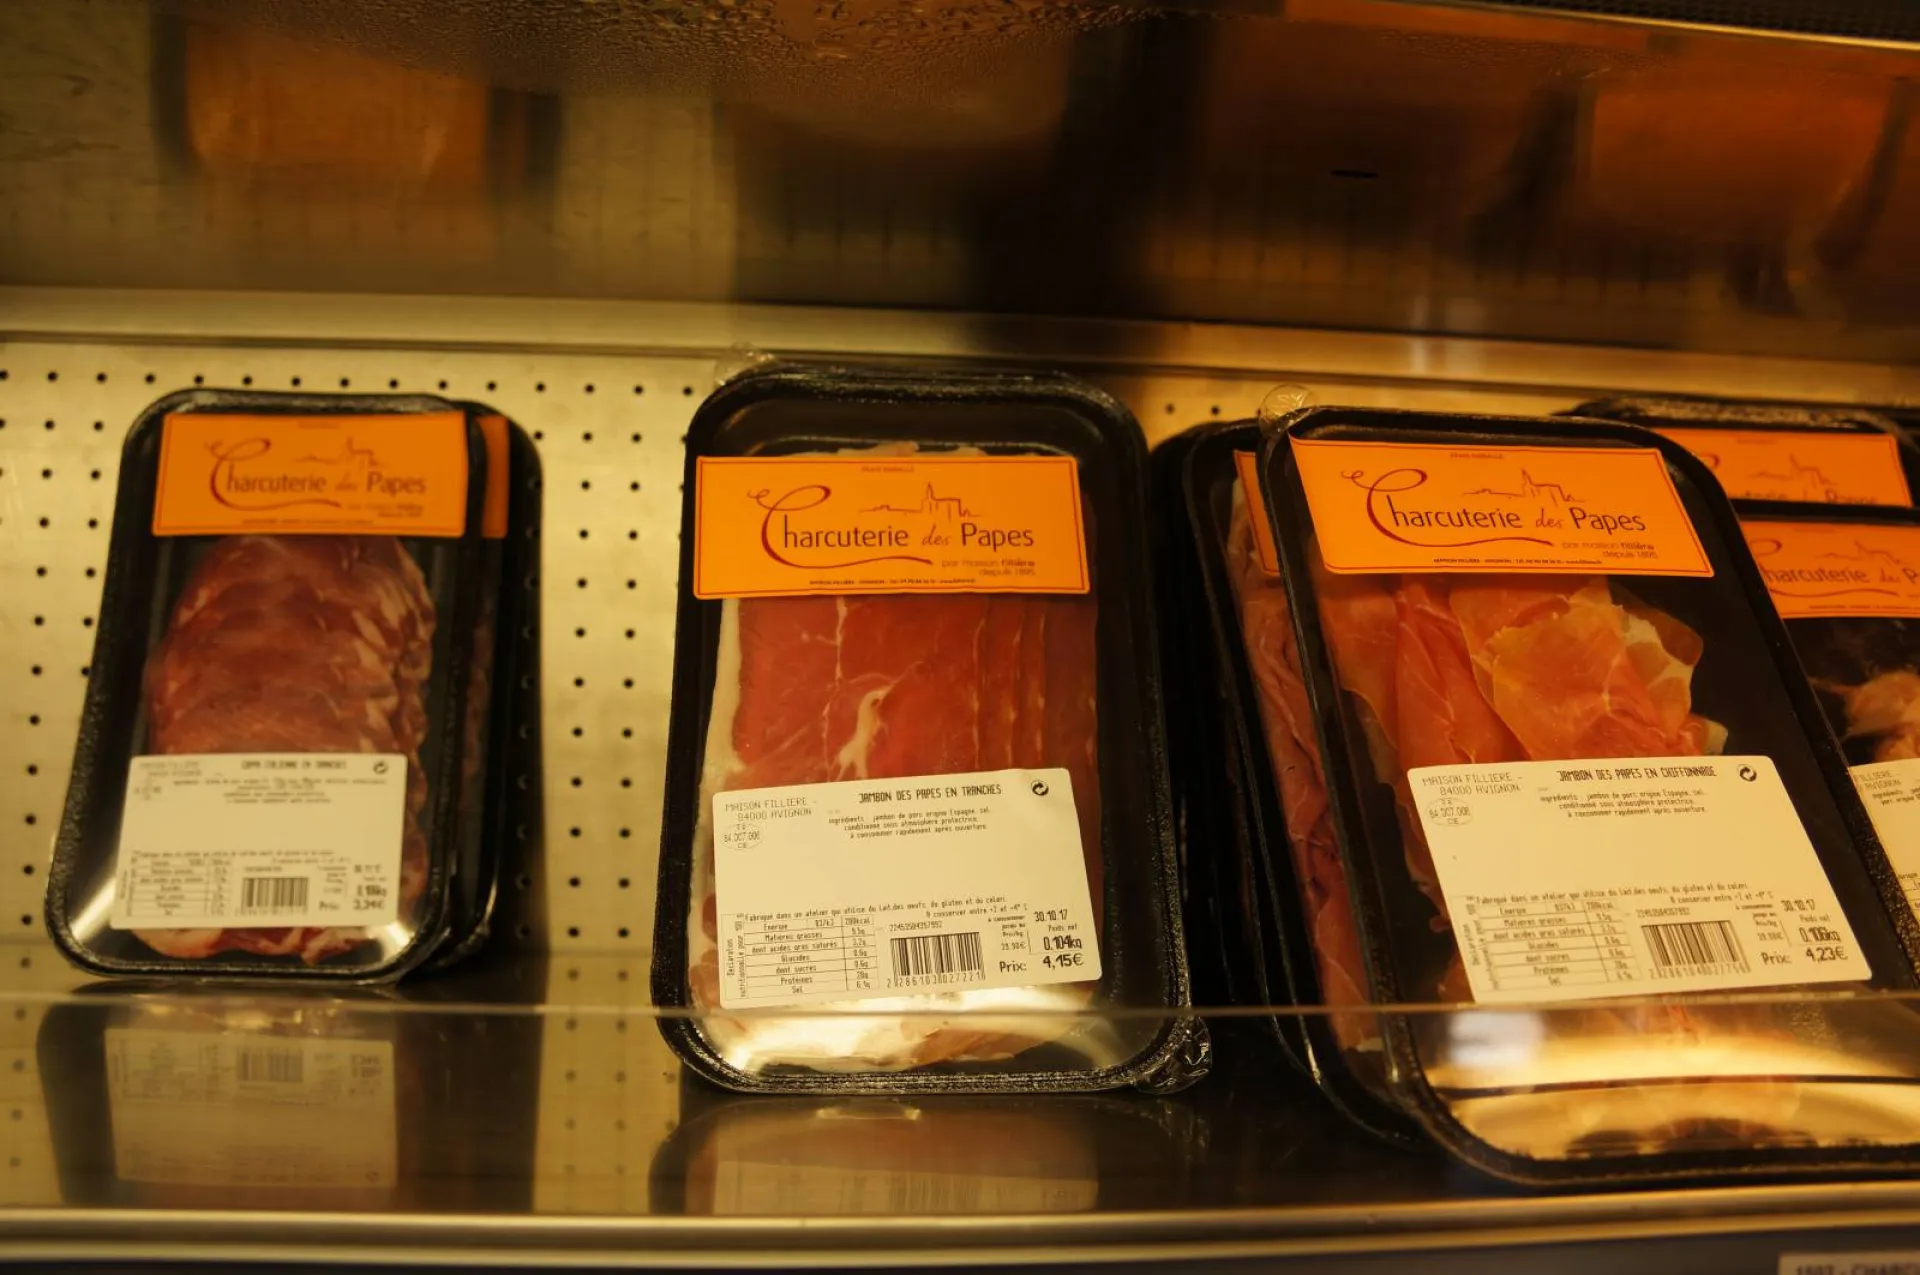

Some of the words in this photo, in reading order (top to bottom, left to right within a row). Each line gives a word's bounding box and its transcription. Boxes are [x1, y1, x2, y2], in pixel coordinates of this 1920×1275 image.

[203, 437, 327, 511] Charcuterie
[366, 470, 427, 497] Papes
[1341, 469, 1523, 547] Charcuterie
[1535, 508, 1563, 528] des
[1569, 507, 1646, 535] Papes
[747, 485, 909, 568] Charcuterie
[921, 523, 952, 546] des
[960, 522, 1034, 552] Papes
[1422, 775, 1462, 786] MAISON
[1465, 772, 1513, 783] FILLIERE
[1556, 769, 1593, 781] JAMBON
[1595, 769, 1612, 781] DES
[1615, 768, 1642, 780] PAPES
[1645, 767, 1658, 778] EN
[1660, 766, 1717, 777] CHIFFONNADE
[859, 792, 892, 804] JAMBON
[896, 789, 911, 801] DES
[916, 787, 941, 800] PAPES
[946, 786, 957, 798] EN
[962, 784, 1002, 796] TRANCHES
[1440, 785, 1472, 795] 84000
[1475, 783, 1519, 794] AVIGNON
[725, 801, 761, 812] MAISON
[764, 798, 807, 808] FILLIERE
[738, 811, 767, 821] 84000
[771, 809, 812, 819] AVIGNON
[1033, 909, 1068, 922] 30.10.17
[1042, 953, 1084, 970] 4,15€
[1806, 946, 1848, 962] 4,23€
[999, 960, 1027, 973] Prix:
